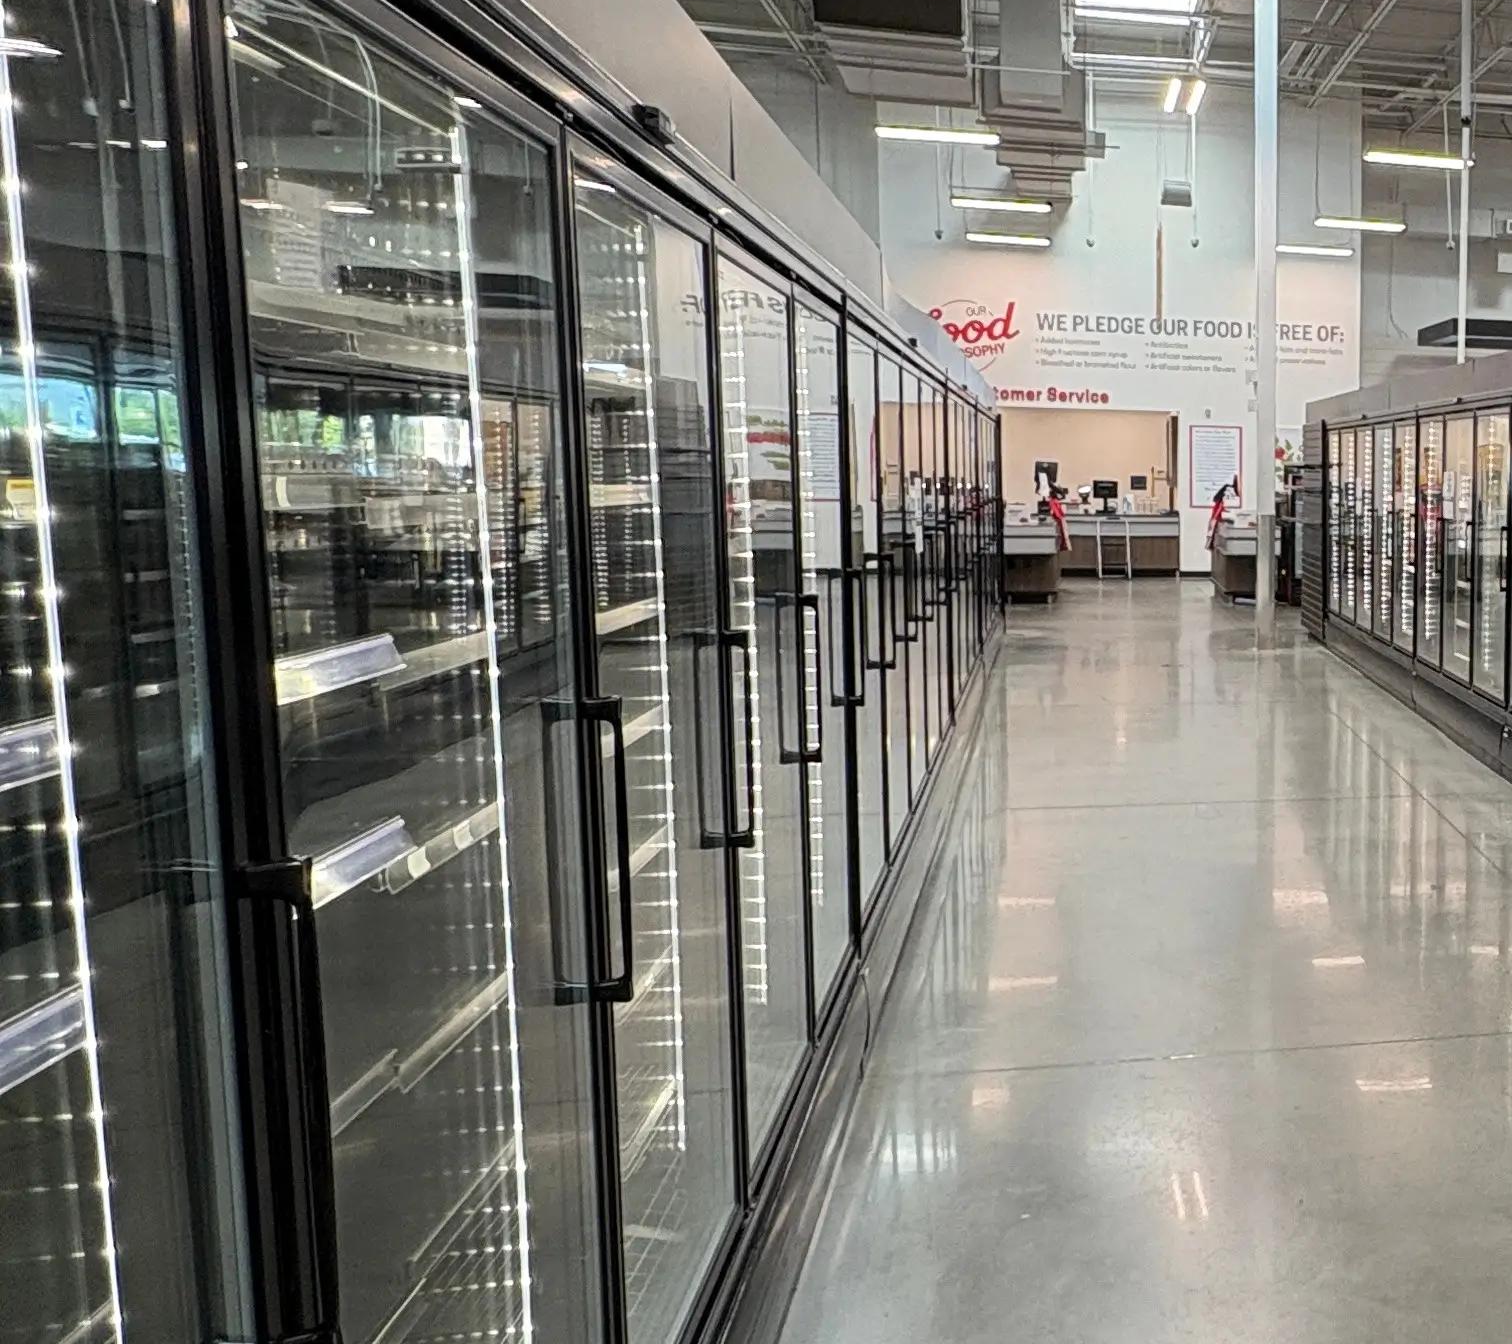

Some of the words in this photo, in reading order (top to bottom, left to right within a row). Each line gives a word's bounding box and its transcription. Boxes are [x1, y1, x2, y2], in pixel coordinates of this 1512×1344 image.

[965, 305, 987, 317] OUR
[929, 301, 1021, 344] ood
[1036, 313, 1068, 332] WE
[1072, 315, 1146, 335] PLEDGE
[1150, 318, 1188, 337] OUR
[1193, 320, 1243, 338] FOOD
[1316, 325, 1345, 343] OF:
[961, 343, 1005, 359] SOPHY
[993, 385, 1042, 402] tomer
[1047, 387, 1110, 404] Service
